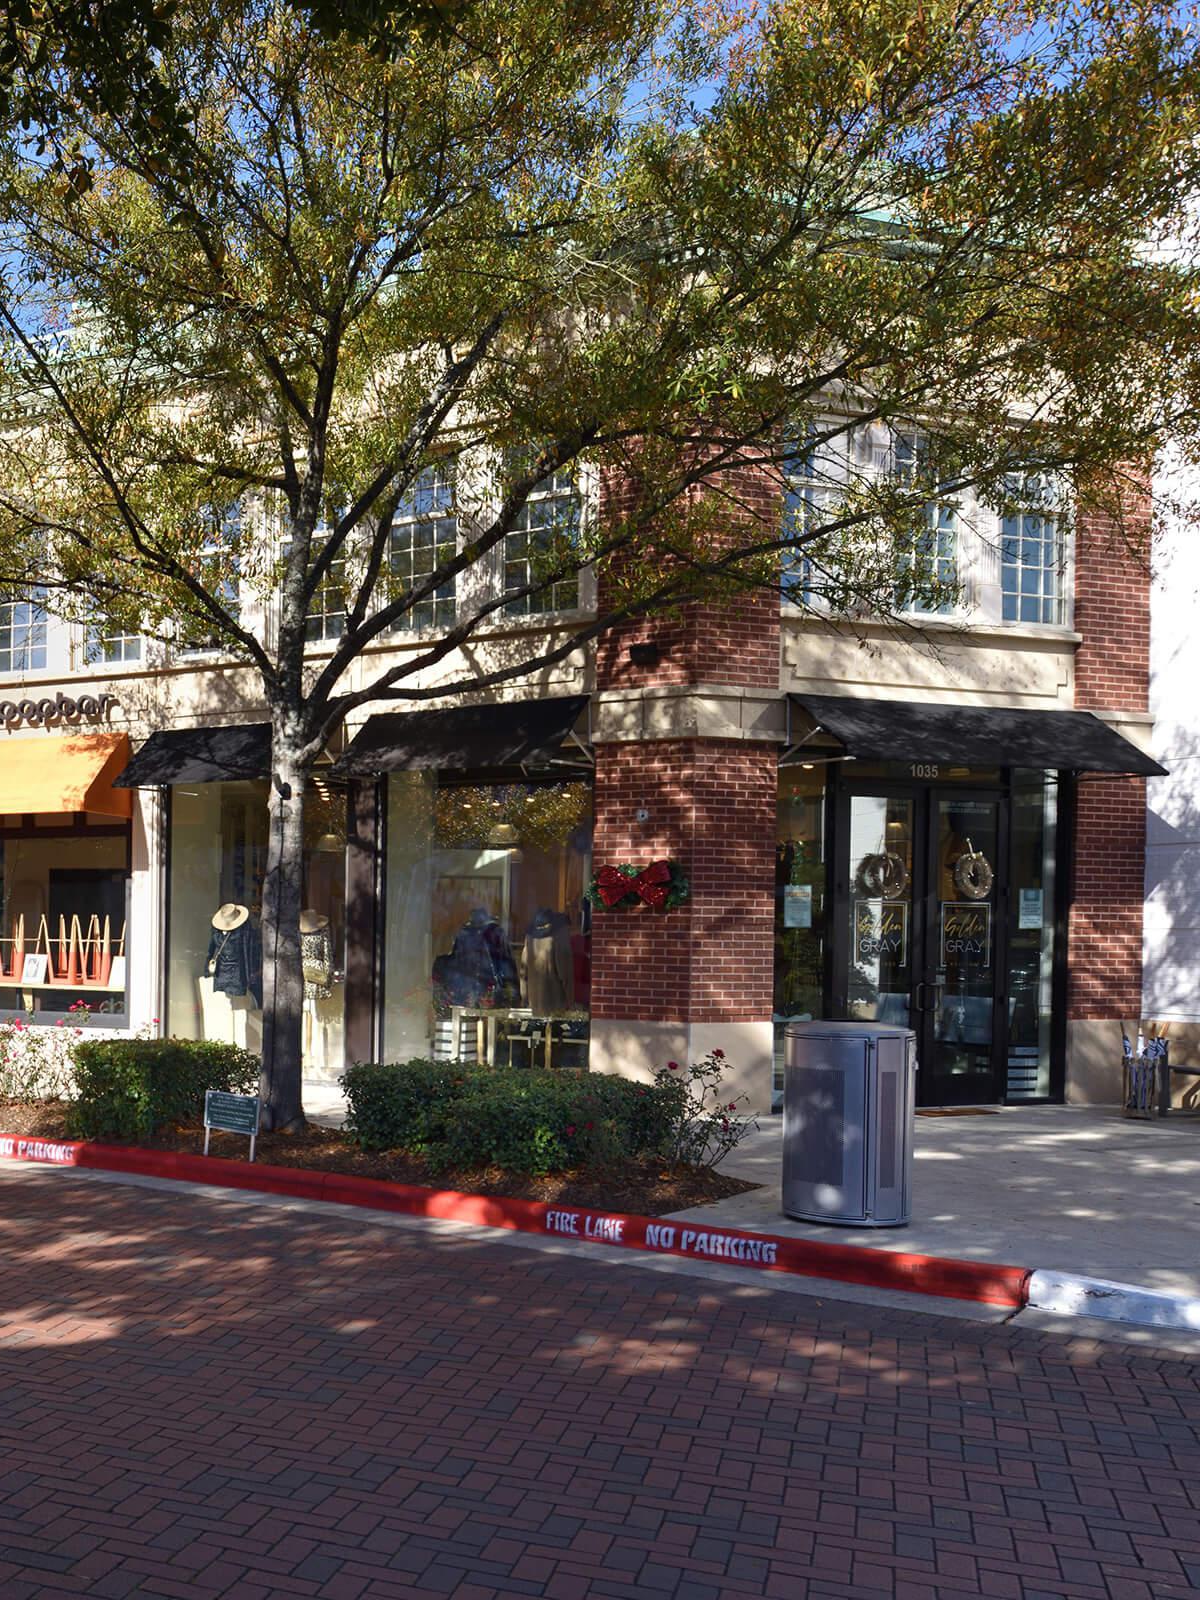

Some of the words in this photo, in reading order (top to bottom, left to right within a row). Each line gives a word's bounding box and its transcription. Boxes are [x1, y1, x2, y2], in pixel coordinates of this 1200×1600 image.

[910, 764, 939, 778] 1035
[860, 940, 901, 953] GRAY
[946, 940, 985, 953] GRAY
[18, 1140, 74, 1161] PARKING
[546, 1210, 580, 1235] FIRE
[585, 1217, 625, 1241] LANE
[646, 1224, 677, 1248] NO
[681, 1230, 778, 1264] PARKING
